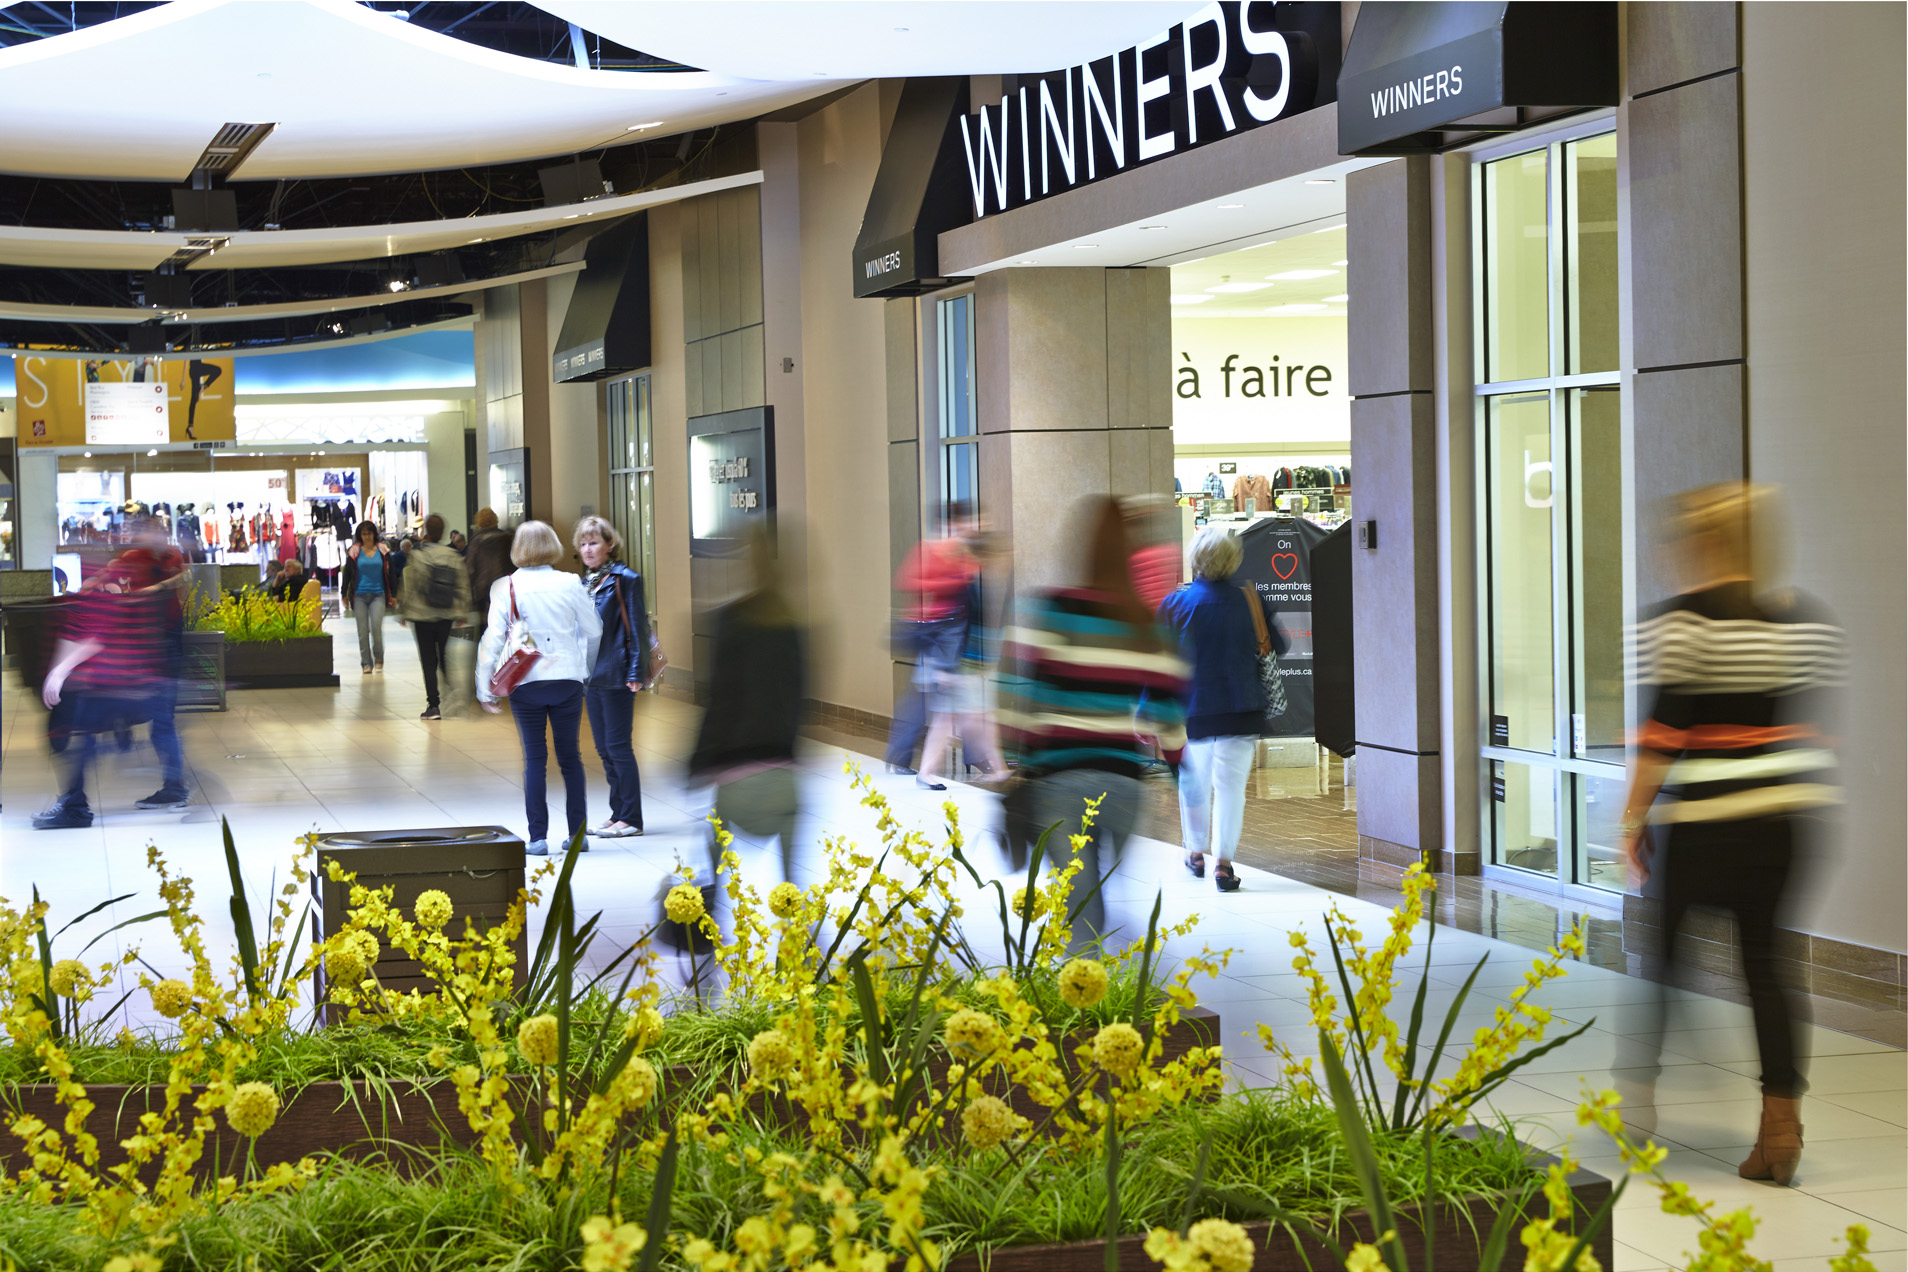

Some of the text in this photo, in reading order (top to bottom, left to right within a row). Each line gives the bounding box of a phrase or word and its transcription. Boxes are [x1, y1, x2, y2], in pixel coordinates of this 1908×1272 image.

[960, 1, 1291, 218] WINNERS
[1371, 65, 1463, 119] WINNERS
[865, 250, 901, 279] WINNERS
[1176, 352, 1332, 399] à faire
[1277, 539, 1292, 549] On
[1255, 582, 1270, 591] les
